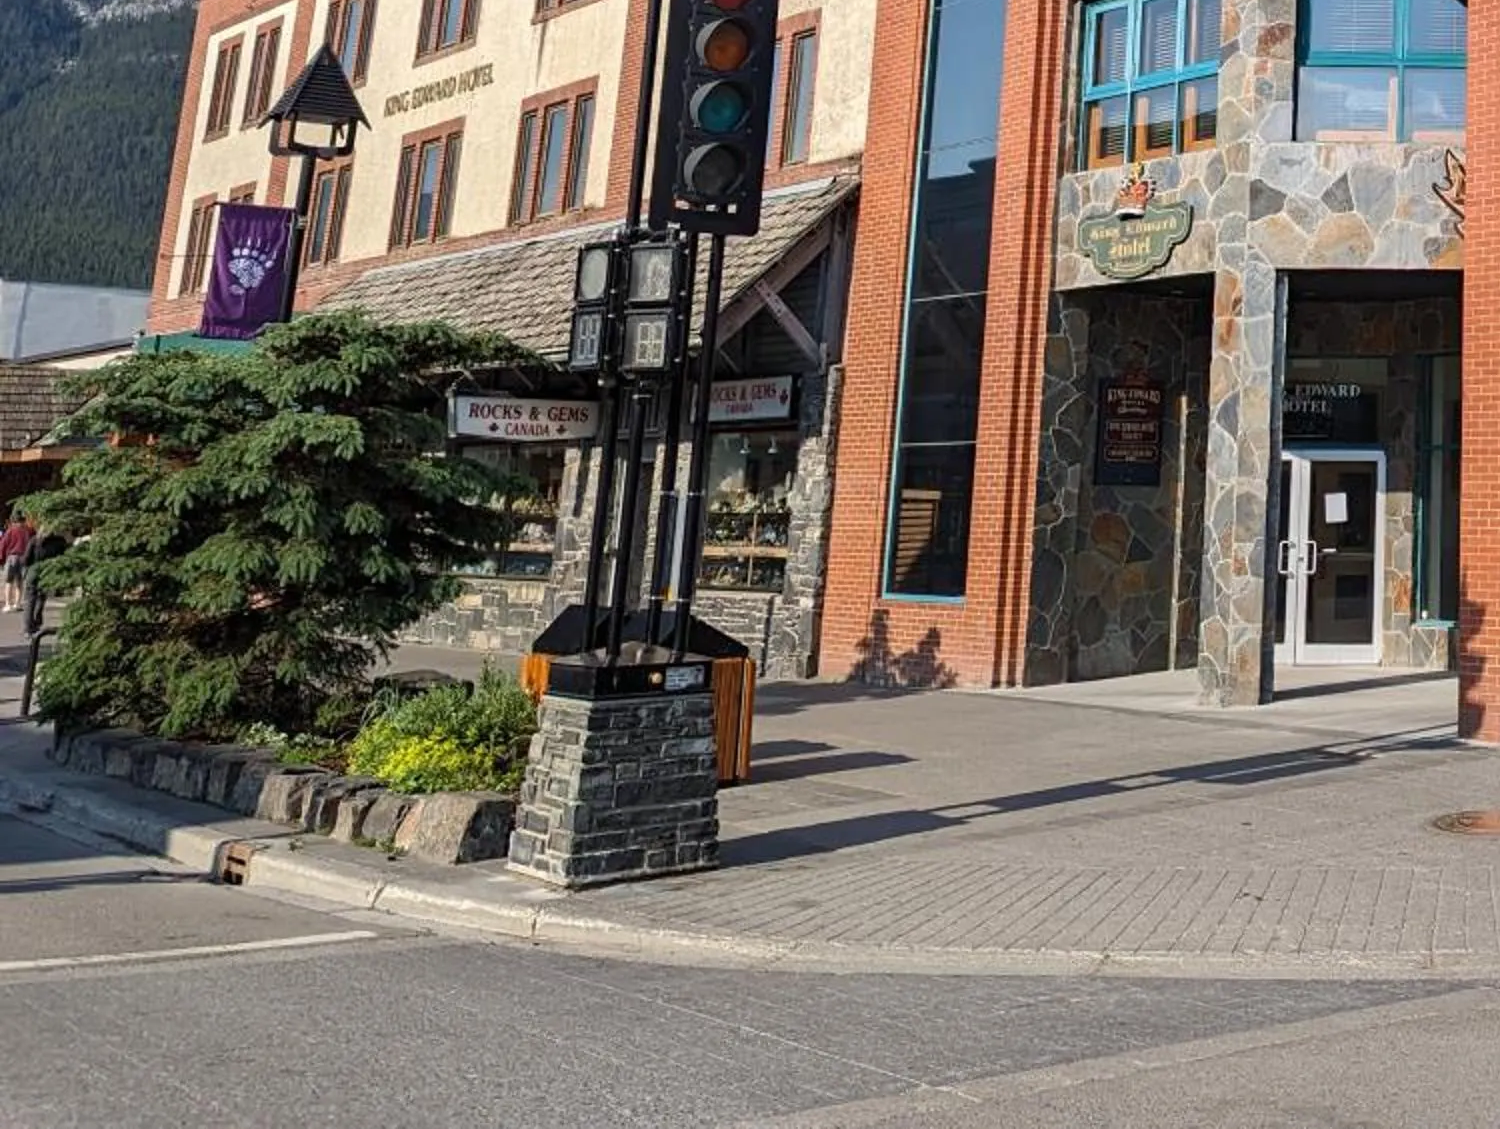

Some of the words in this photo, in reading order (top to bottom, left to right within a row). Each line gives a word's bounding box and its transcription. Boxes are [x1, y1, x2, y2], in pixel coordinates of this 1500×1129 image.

[384, 90, 410, 118] KING
[411, 76, 457, 110] EDWARD
[458, 63, 494, 94] HOTEL
[1295, 382, 1362, 400] EDWARD
[468, 402, 523, 421] ROCKS
[528, 406, 540, 422] &
[546, 406, 589, 424] GEMS
[504, 422, 551, 437] CANADA
